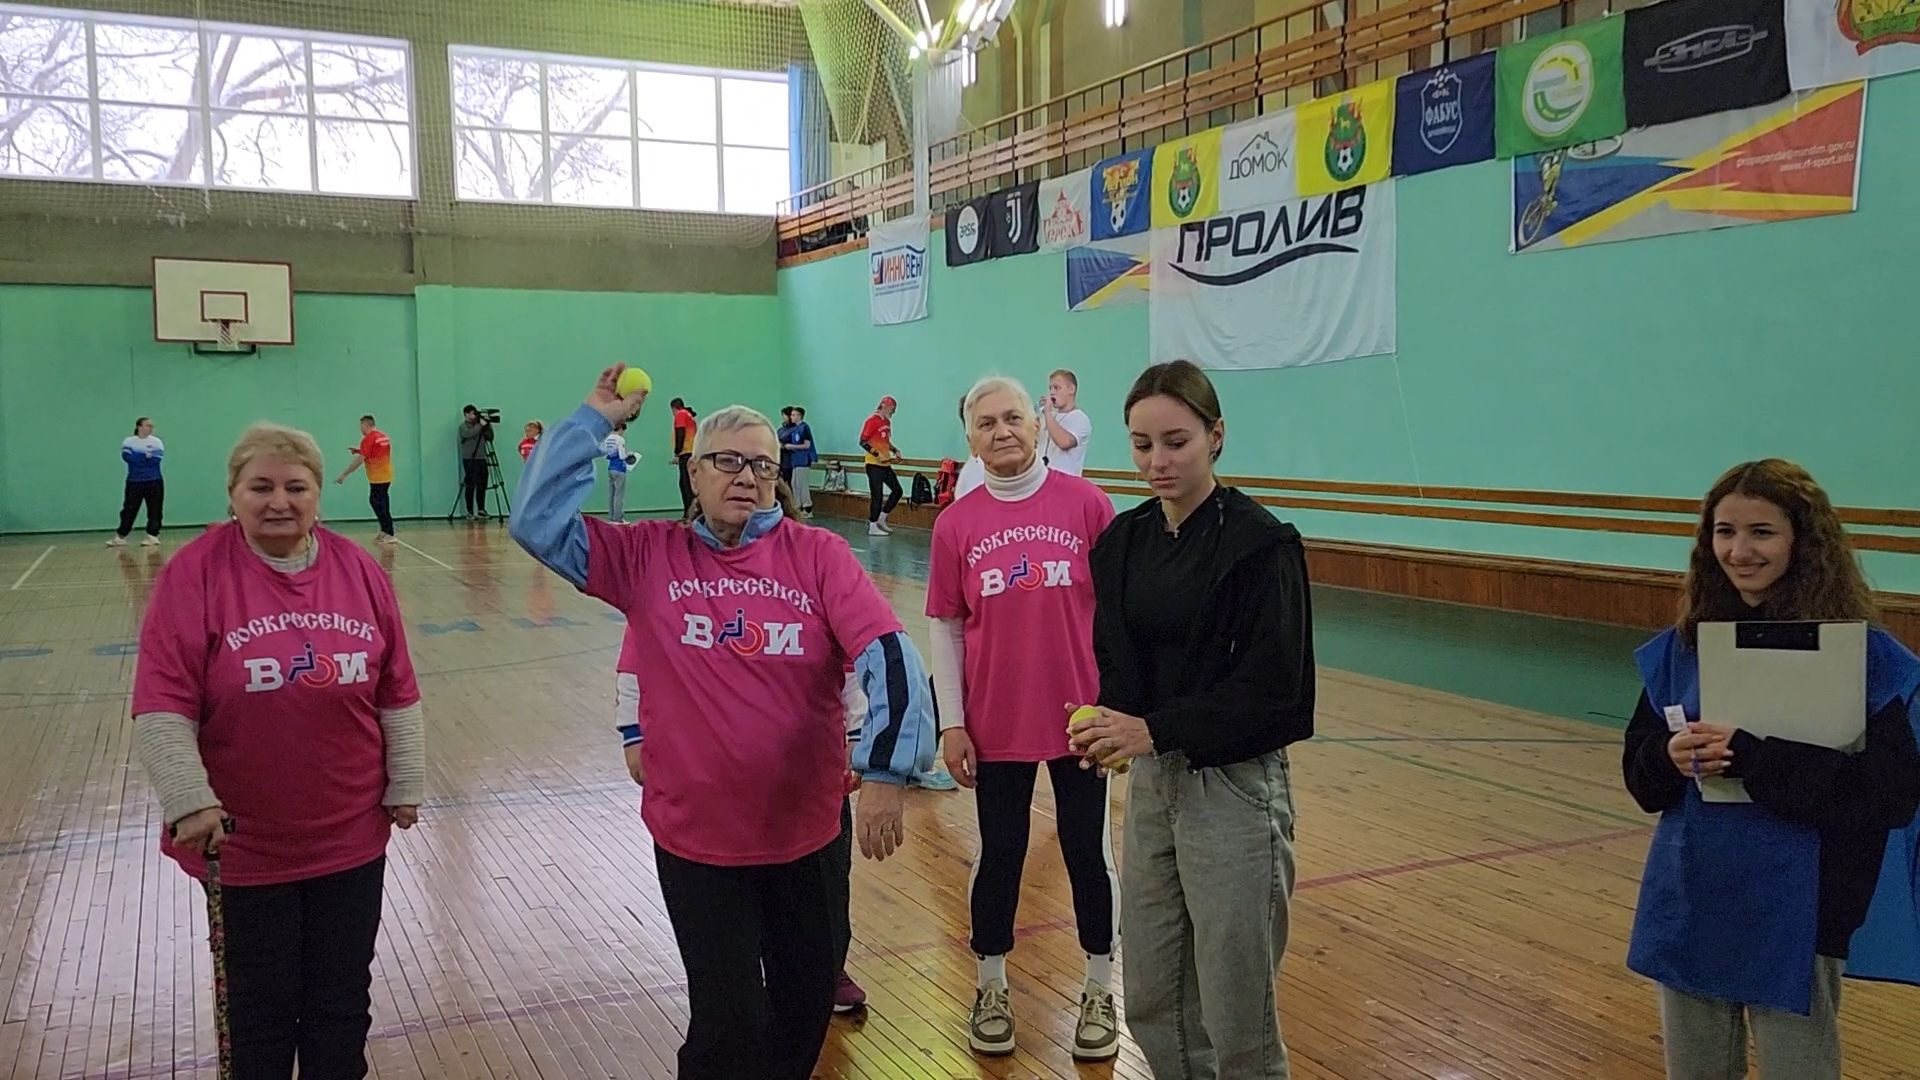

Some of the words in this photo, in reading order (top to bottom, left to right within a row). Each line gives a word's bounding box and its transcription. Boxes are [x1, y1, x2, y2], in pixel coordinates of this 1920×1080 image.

[1426, 100, 1458, 126] ФАБУС
[1229, 147, 1289, 180] ДОМОК
[1177, 184, 1367, 263] ПРОЛИВ
[967, 524, 1084, 569] ВОСКРЕСЕНСК
[226, 611, 375, 652] ВОСКРЕСЕНСК
